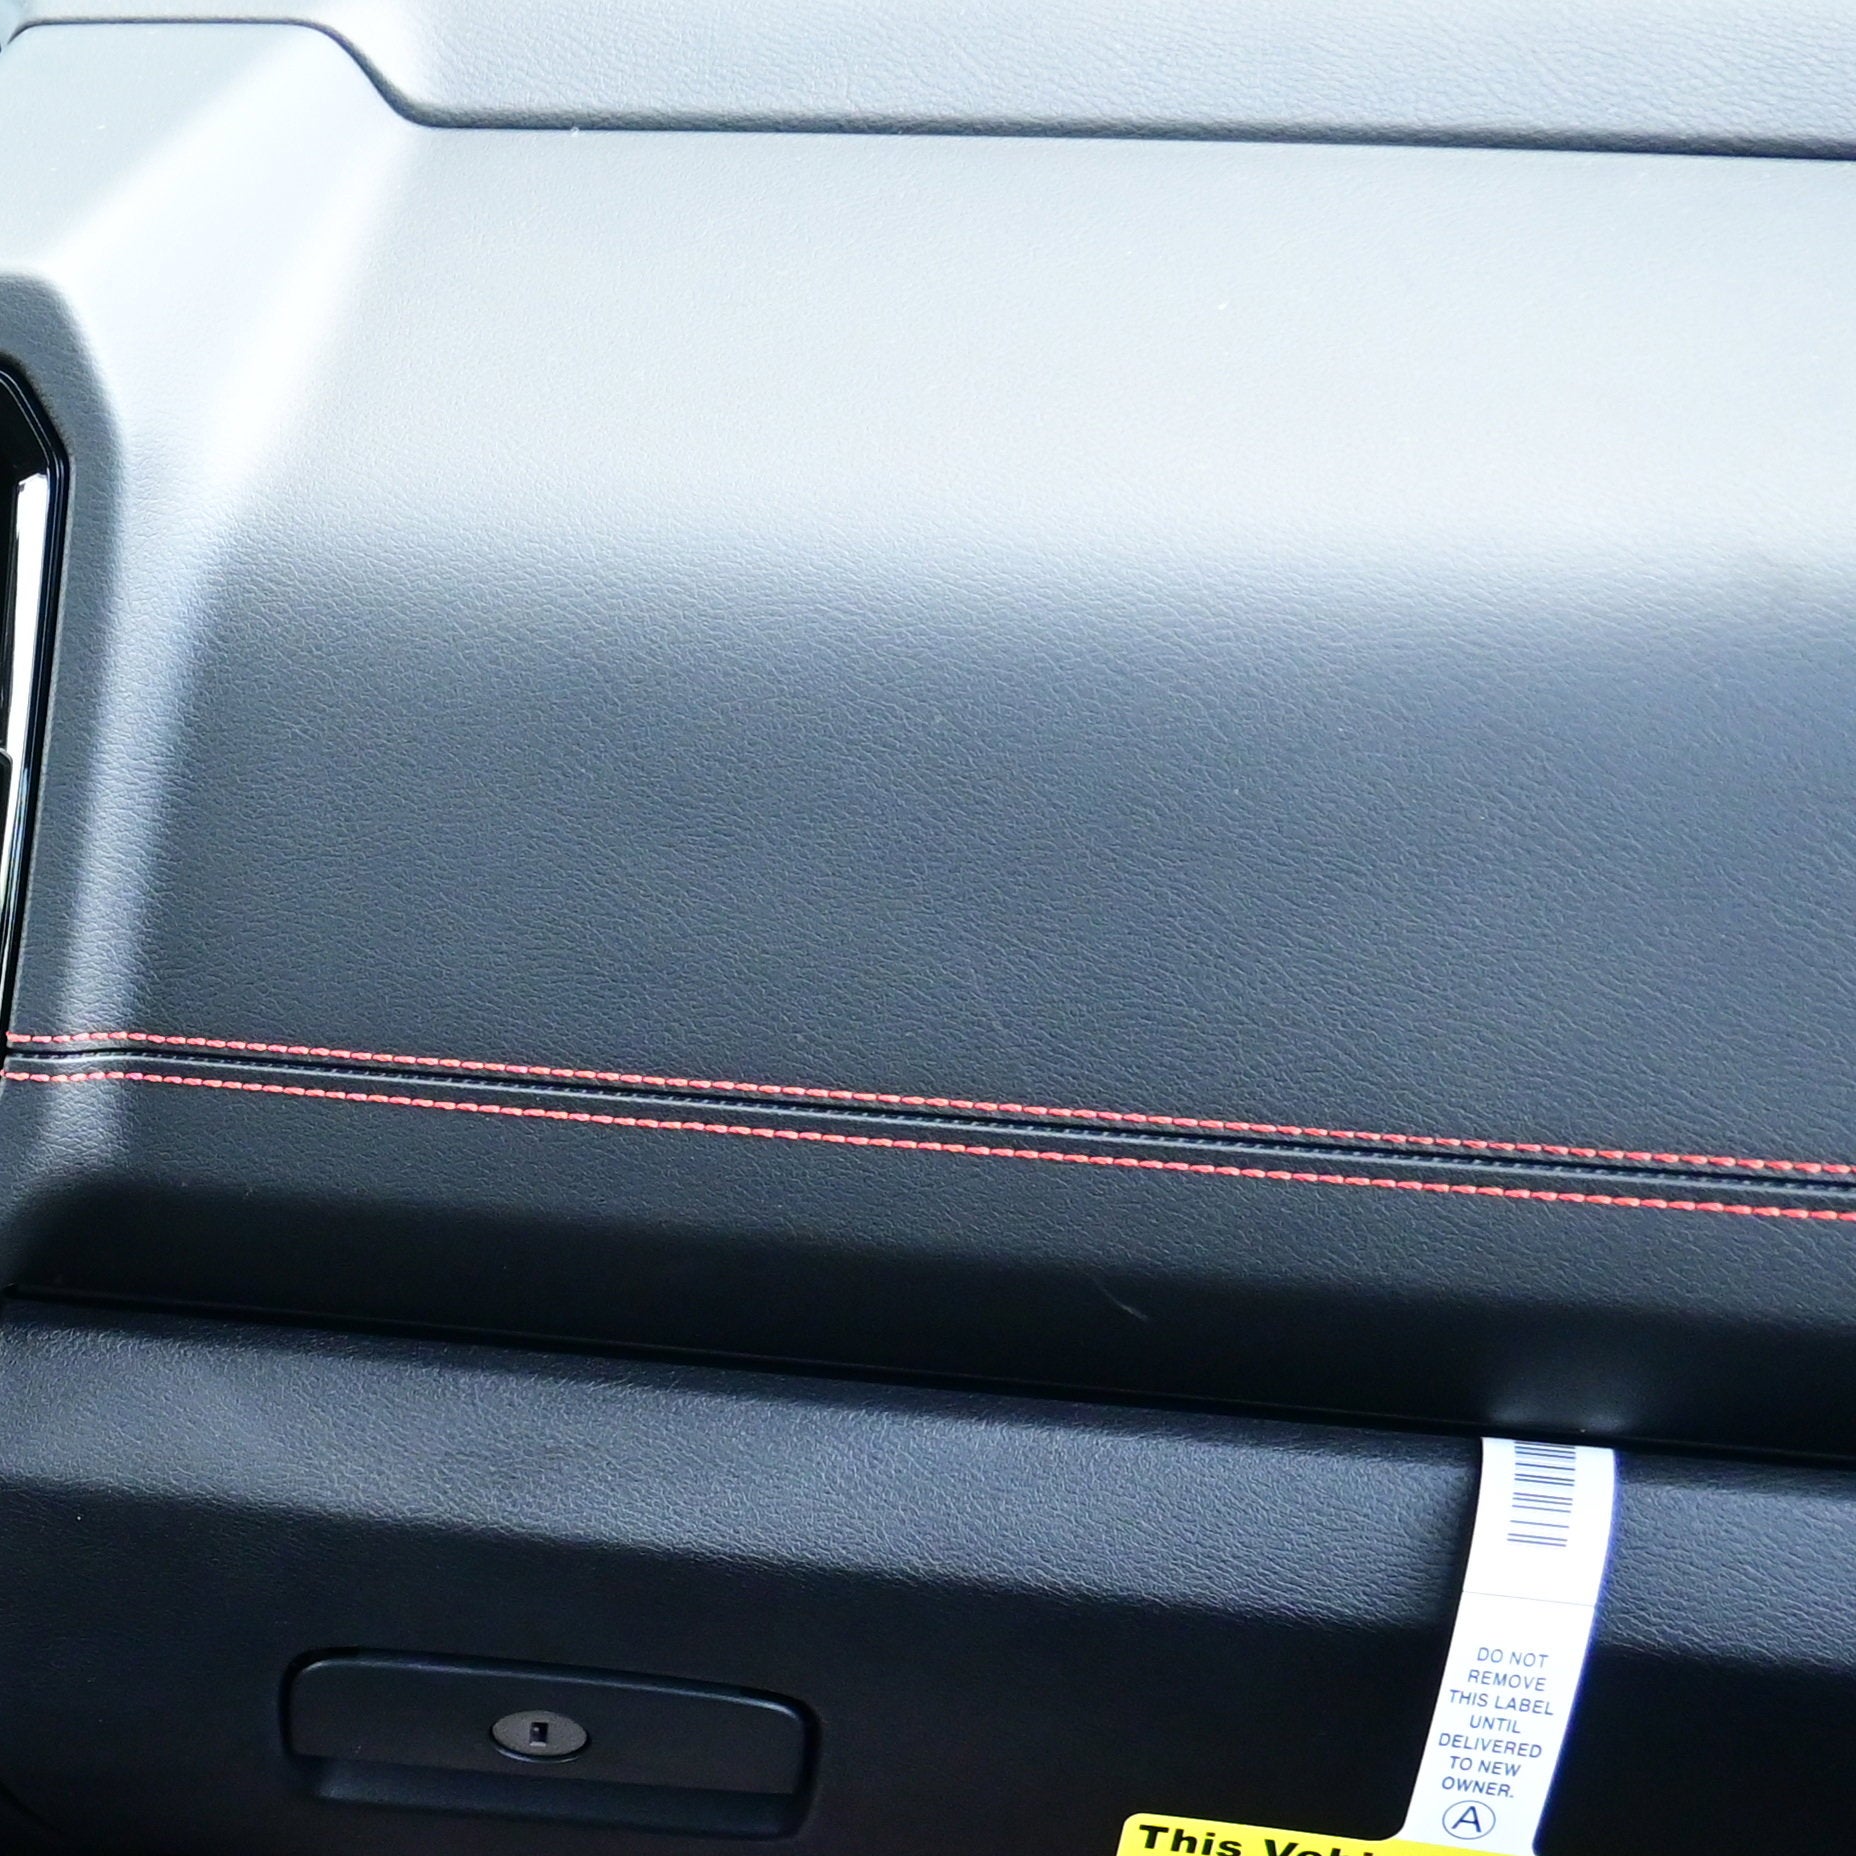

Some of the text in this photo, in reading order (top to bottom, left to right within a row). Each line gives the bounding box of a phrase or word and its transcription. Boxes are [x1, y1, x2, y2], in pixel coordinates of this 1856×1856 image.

[1477, 1647, 1549, 1668] DO NOT
[1467, 1669, 1547, 1691] REMOVE
[1450, 1689, 1554, 1716] THIS LABEL
[1469, 1714, 1521, 1734] UNTIL
[1438, 1732, 1542, 1759] DELIVERED
[1450, 1755, 1521, 1777] TO NEW
[1441, 1776, 1514, 1798] OWNER.
